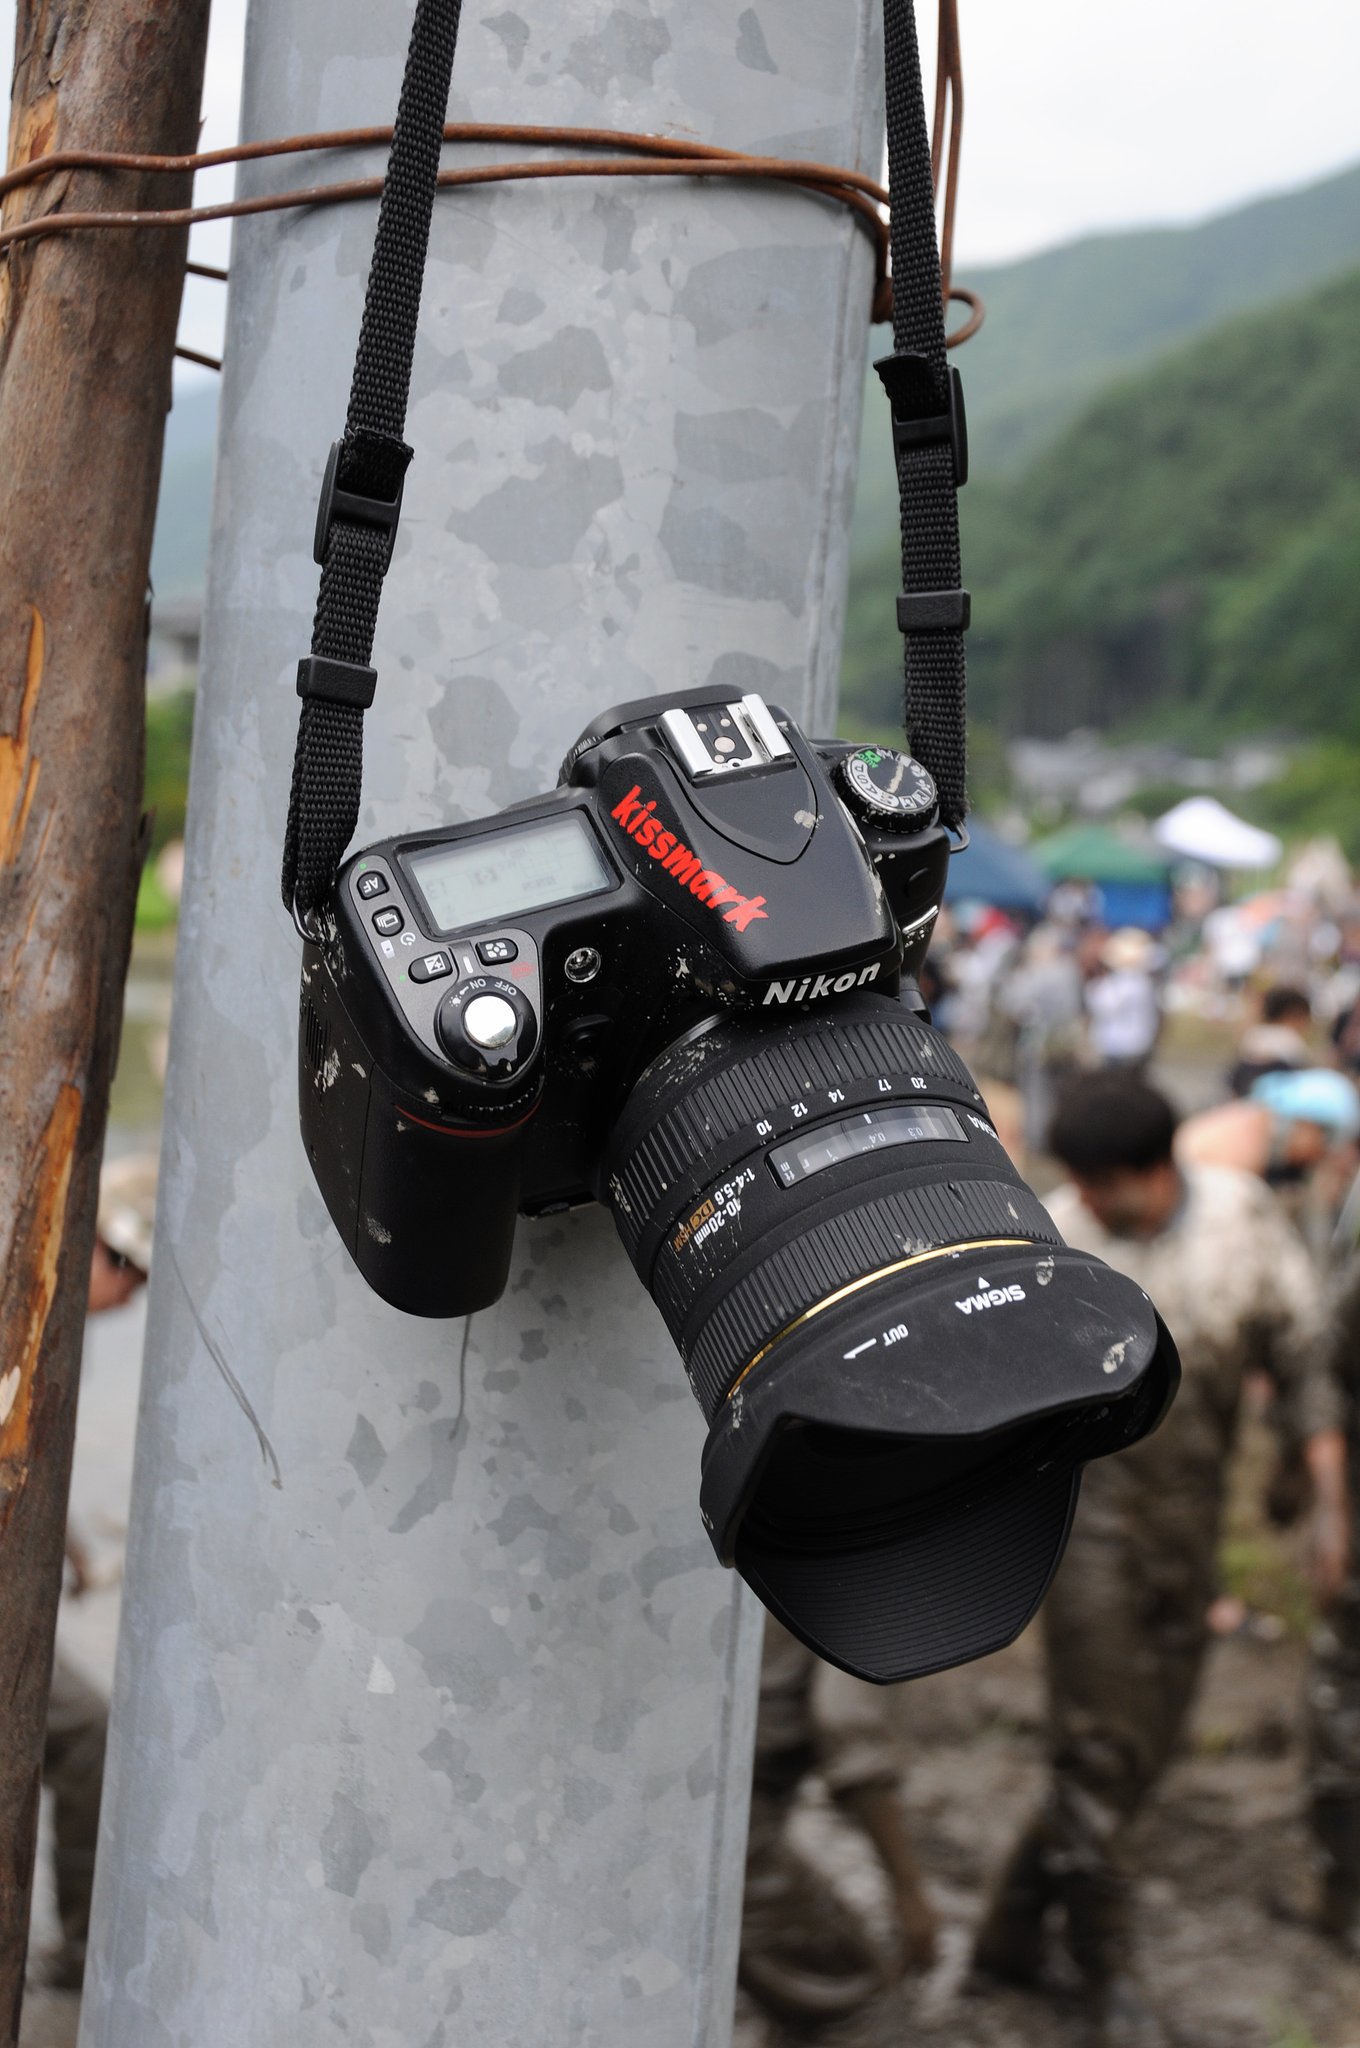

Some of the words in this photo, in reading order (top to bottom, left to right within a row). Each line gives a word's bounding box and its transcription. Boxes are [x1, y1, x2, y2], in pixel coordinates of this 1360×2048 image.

[611, 785, 769, 933] kissmark
[363, 877, 378, 894] AF
[469, 978, 486, 990] ON
[494, 980, 517, 996] OFF
[762, 962, 881, 1006] Nikon
[756, 1119, 772, 1136] 10
[791, 1102, 808, 1118] 12
[828, 1089, 845, 1103] 14
[878, 1078, 892, 1092] 17
[911, 1077, 927, 1089] 20
[869, 1132, 886, 1144] 0.4
[908, 1126, 924, 1137] 0.3
[714, 1167, 756, 1206] 1:4-5.6
[690, 1199, 715, 1231] DC
[693, 1197, 742, 1245] 10-20mm
[954, 1284, 1026, 1315] SIGMA
[882, 1323, 909, 1347] OUT
